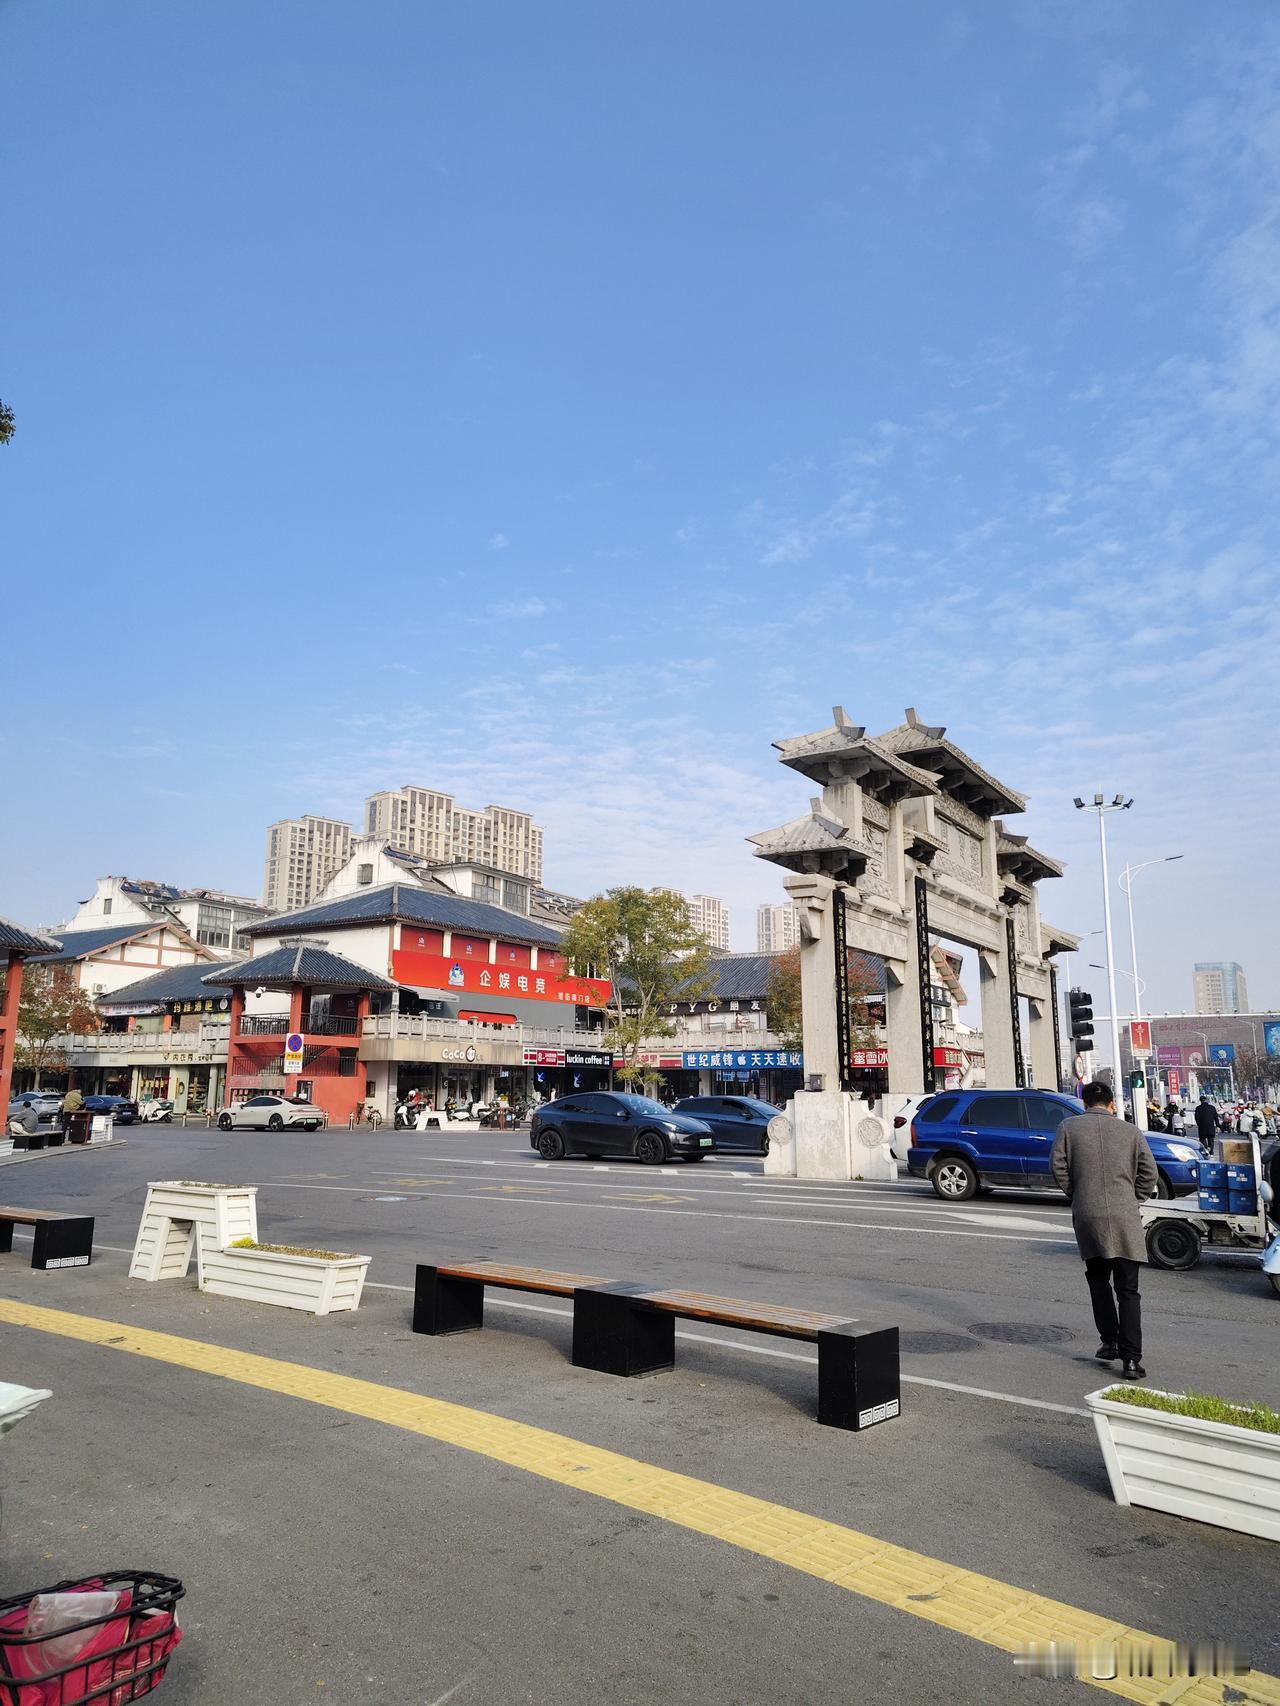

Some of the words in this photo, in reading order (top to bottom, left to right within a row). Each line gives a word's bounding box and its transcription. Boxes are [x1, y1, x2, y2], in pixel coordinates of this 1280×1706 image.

[479, 969, 546, 995] 企娱电竞
[729, 1000, 761, 1011] 朋友
[566, 1053, 584, 1064] luckin
[584, 1055, 603, 1066] coffee
[686, 1054, 733, 1067] 世纪威锋
[750, 1053, 801, 1066] 天天速收
